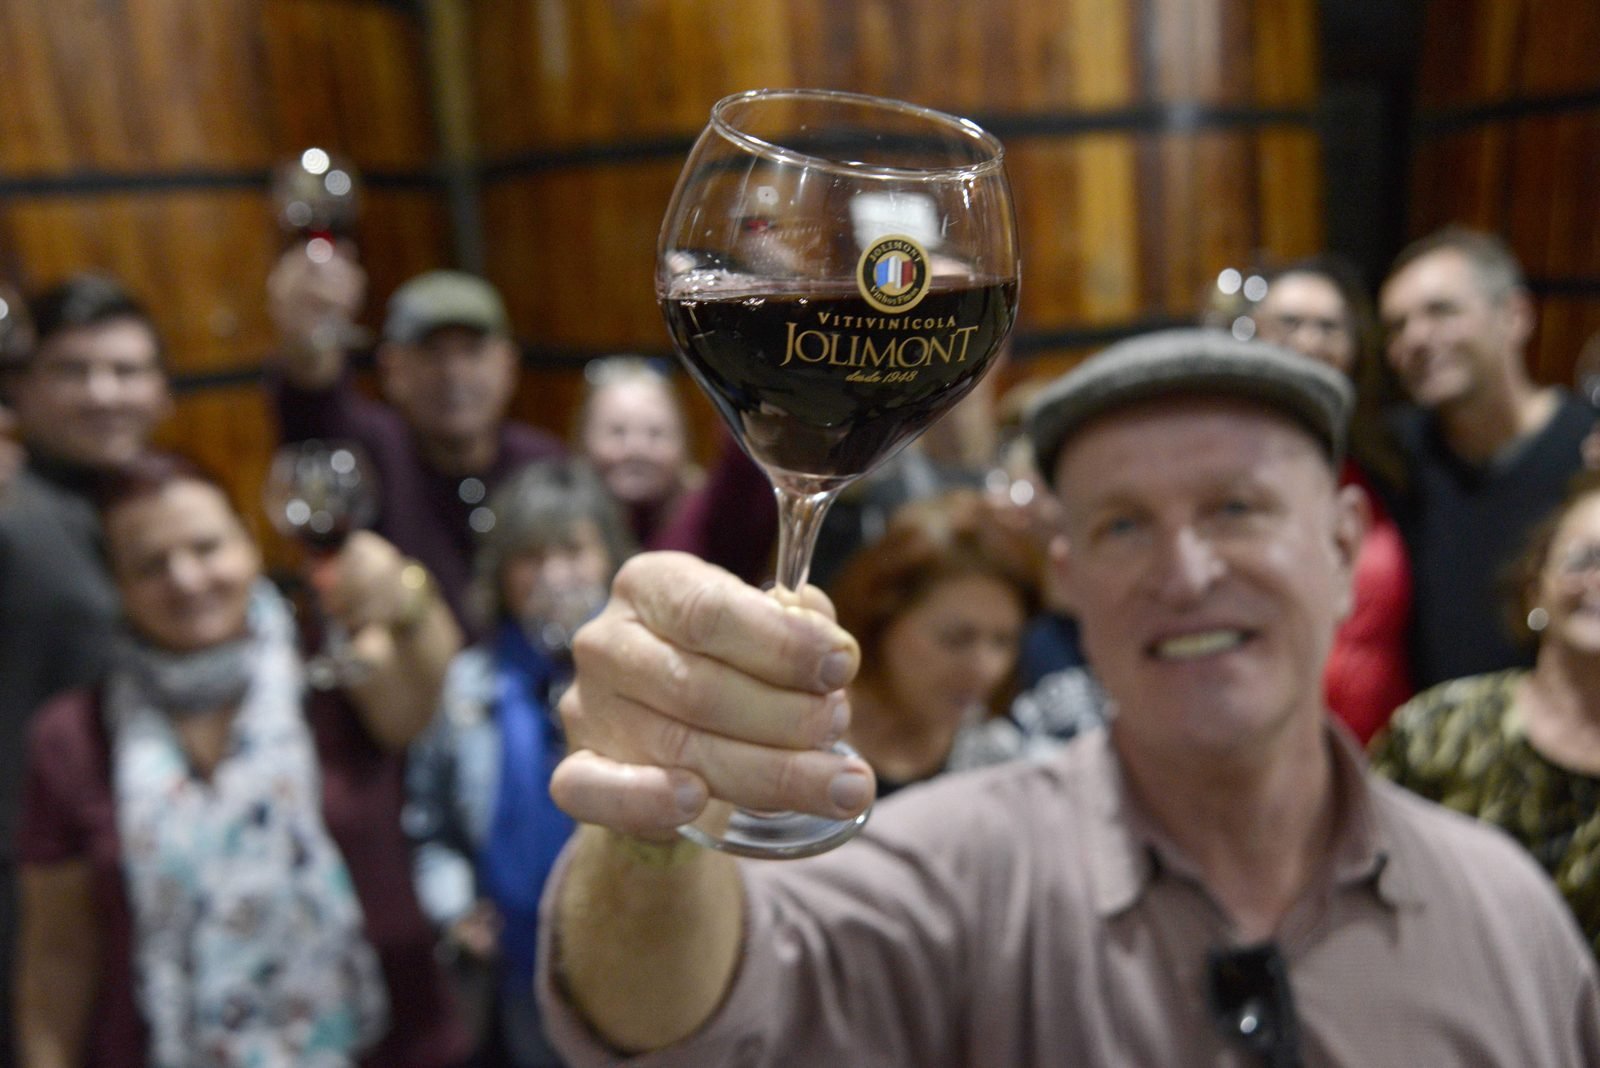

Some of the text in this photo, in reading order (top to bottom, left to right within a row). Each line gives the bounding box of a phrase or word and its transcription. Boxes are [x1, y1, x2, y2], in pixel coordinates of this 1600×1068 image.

[869, 241, 921, 262] JOLIMONT
[817, 312, 956, 330] VITIVINÍCOLA
[779, 321, 979, 368] JOLIMONT
[882, 370, 918, 384] 1948
